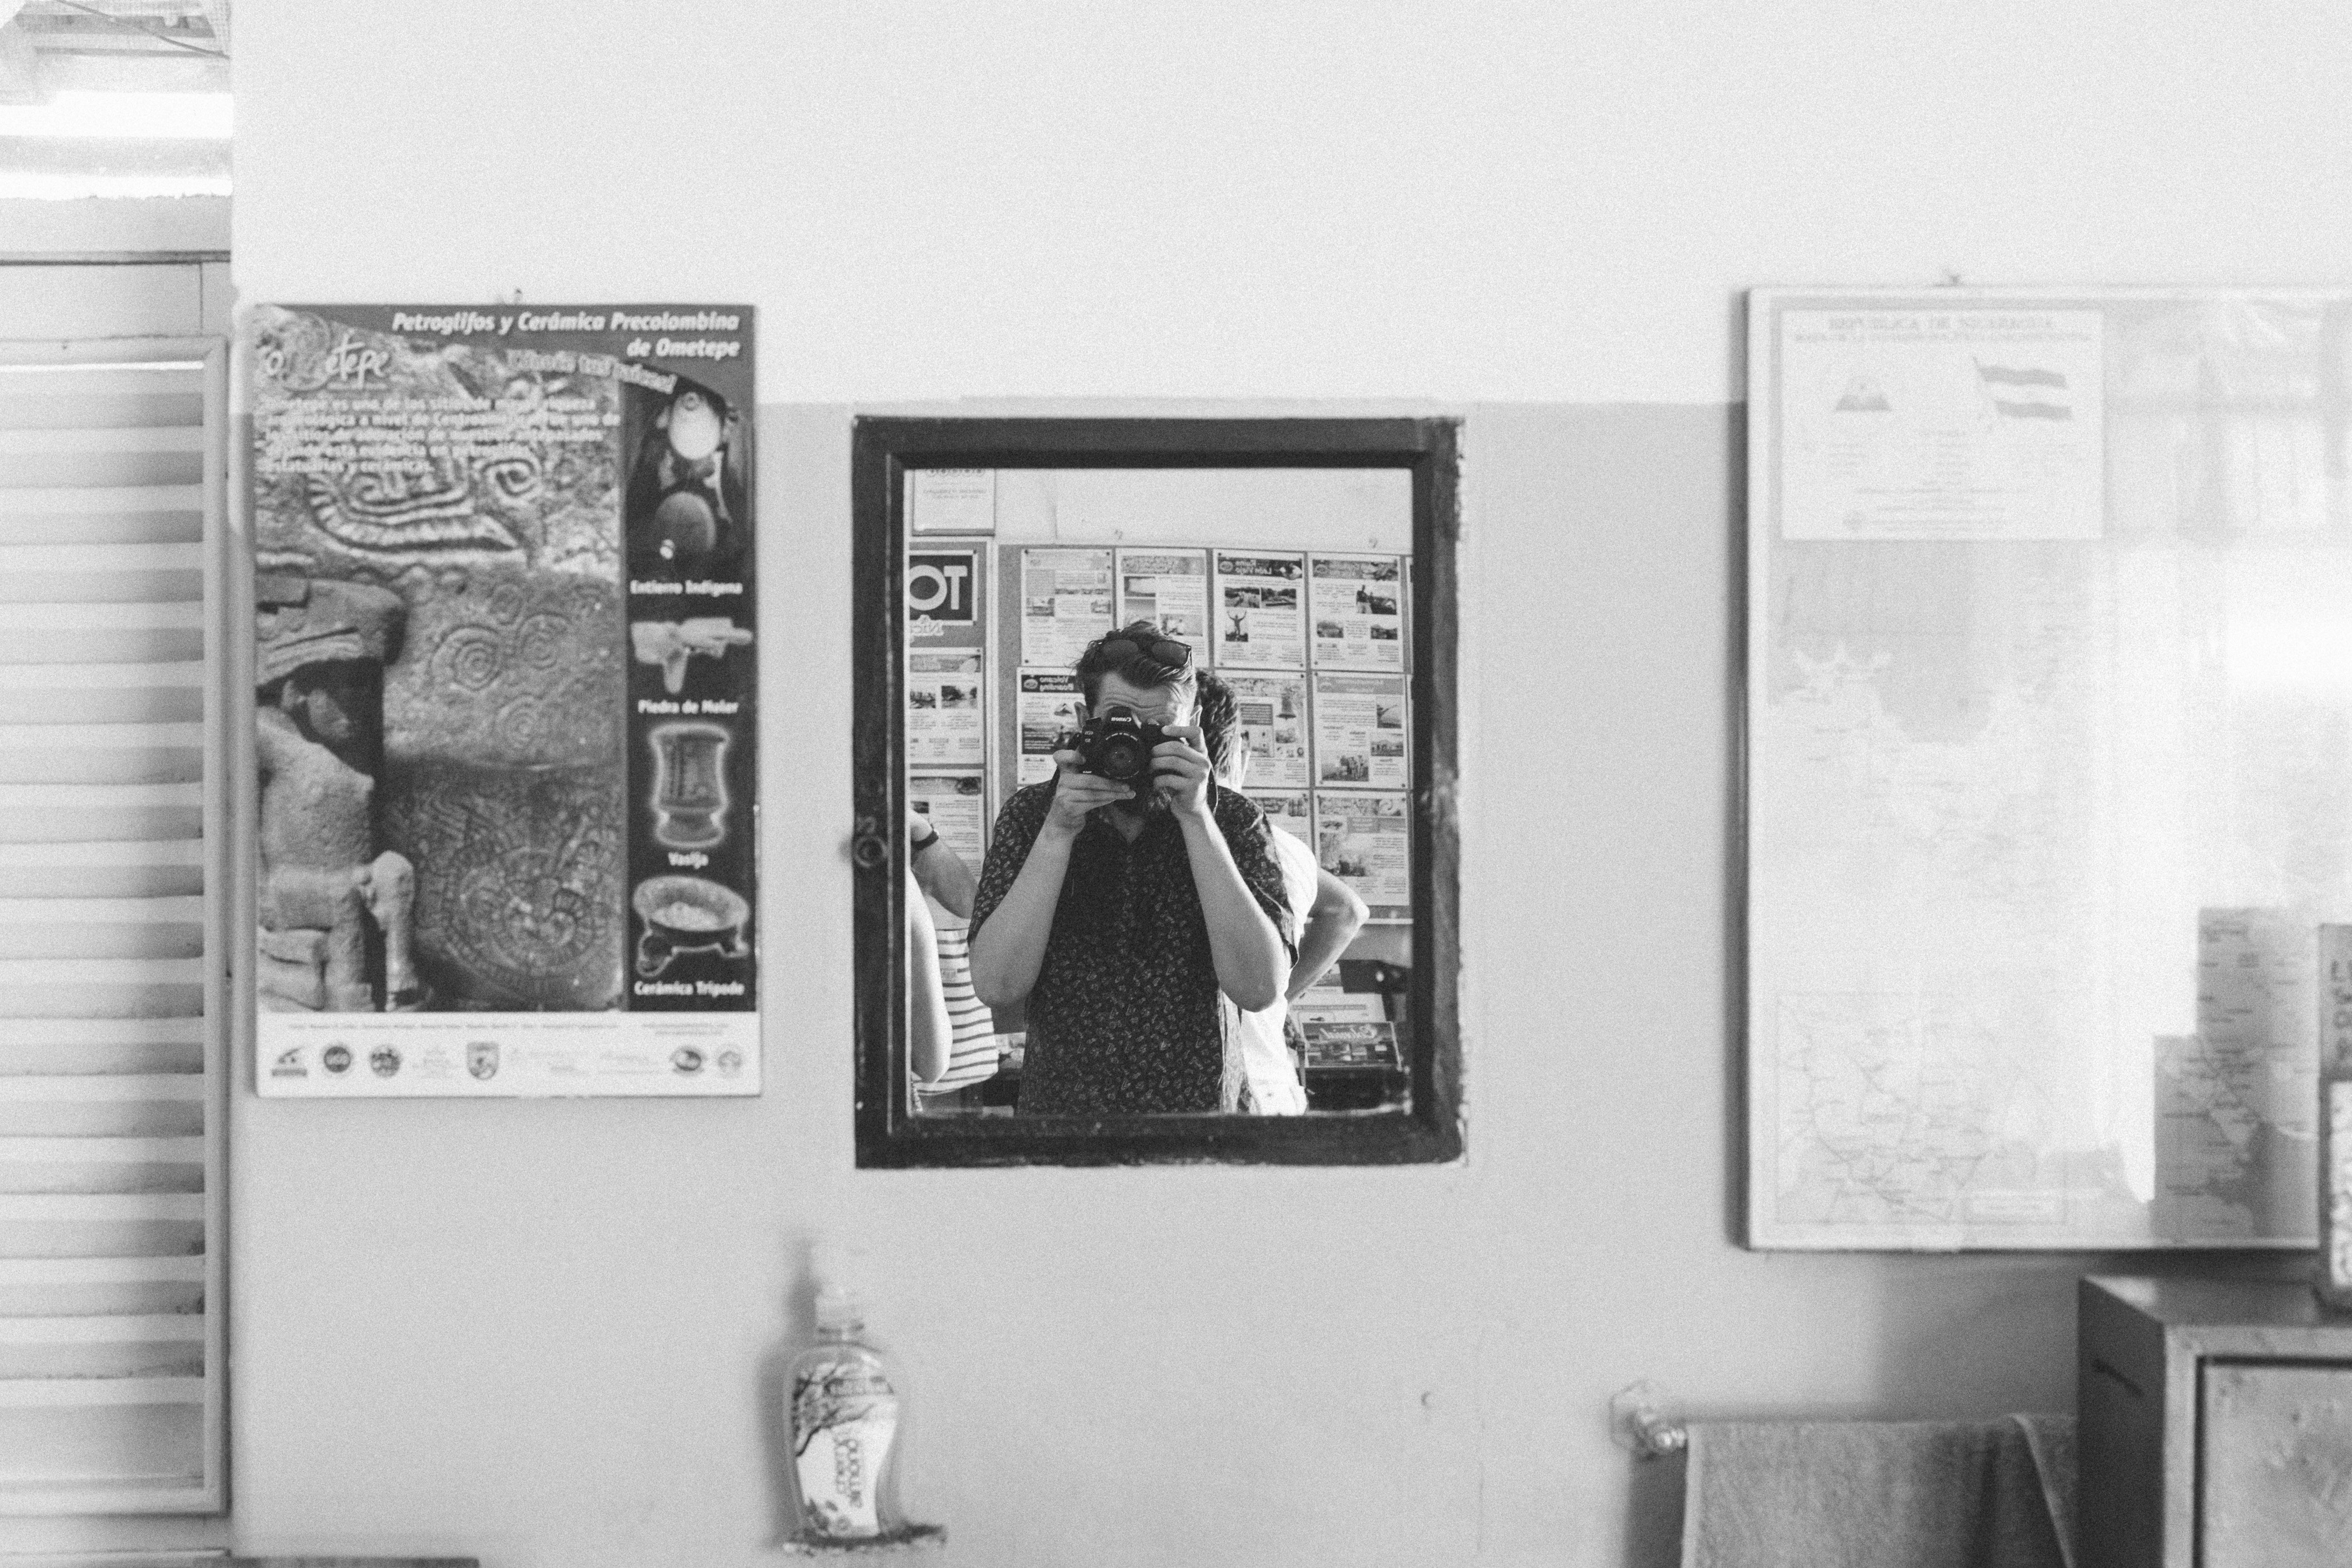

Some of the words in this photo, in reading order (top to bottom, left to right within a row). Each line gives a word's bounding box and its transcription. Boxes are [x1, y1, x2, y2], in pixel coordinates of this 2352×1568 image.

[392, 312, 495, 335] Petroglifos
[498, 315, 513, 335] y
[518, 310, 606, 331] Cerámica
[611, 310, 740, 332] Precolombina
[626, 337, 652, 357] de
[656, 337, 740, 360] Ometepe
[685, 580, 743, 597] Indígena
[638, 699, 680, 713] Piedra
[682, 699, 700, 714] de
[668, 851, 709, 869] Vasija
[634, 980, 693, 995] Cerámica
[696, 980, 745, 998] Trípode
